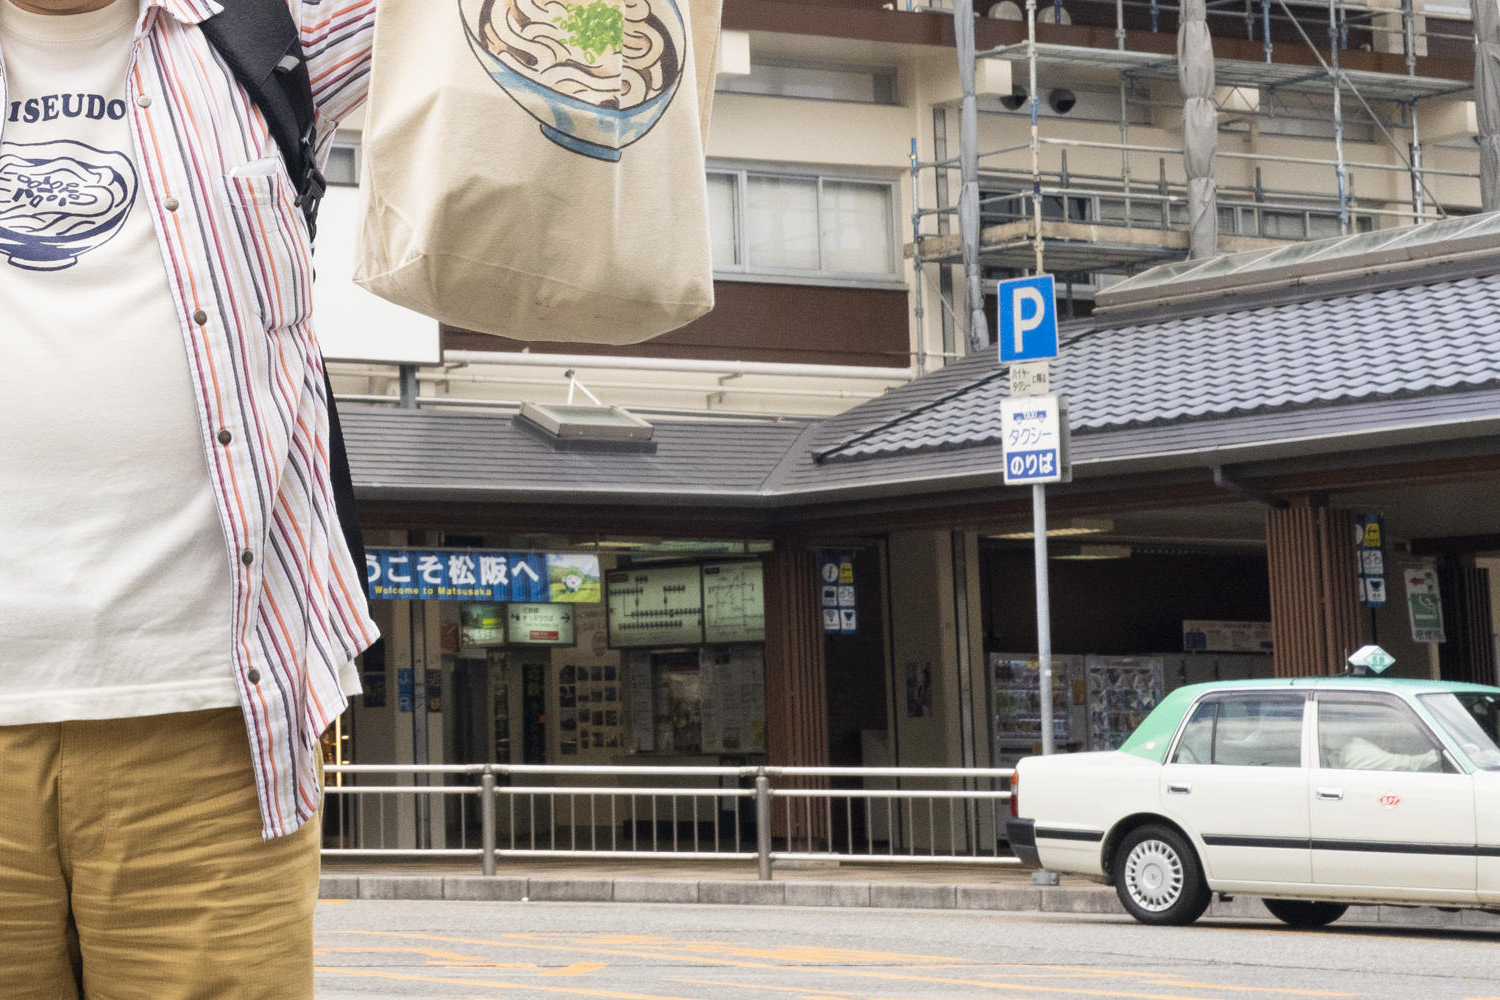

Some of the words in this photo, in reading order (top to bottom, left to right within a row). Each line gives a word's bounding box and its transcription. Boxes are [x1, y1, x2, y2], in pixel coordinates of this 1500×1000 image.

[8, 93, 126, 123] ISEUDO
[1013, 286, 1045, 353] P
[1009, 427, 1052, 446] タクシー
[1010, 453, 1053, 475] のりば
[374, 585, 418, 595] Welcome
[422, 585, 434, 596] to
[437, 585, 492, 597] Matsusaka
